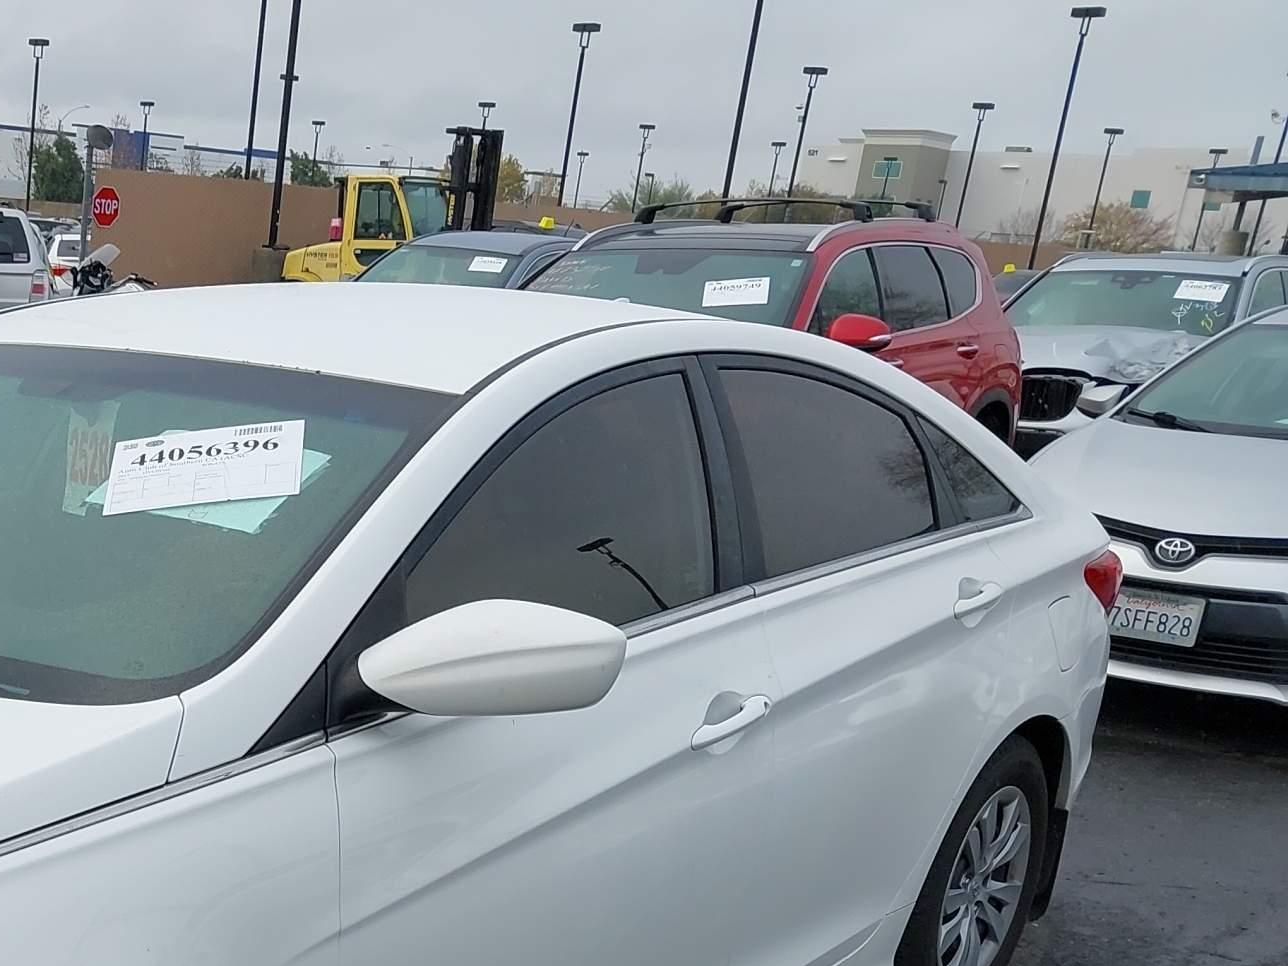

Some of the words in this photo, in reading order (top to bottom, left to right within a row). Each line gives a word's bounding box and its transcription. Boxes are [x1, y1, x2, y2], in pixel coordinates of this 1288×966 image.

[94, 198, 119, 215] STOP
[130, 437, 280, 466] 44056396
[1126, 597, 1185, 612] California
[1111, 605, 1193, 637] 7SFF828
